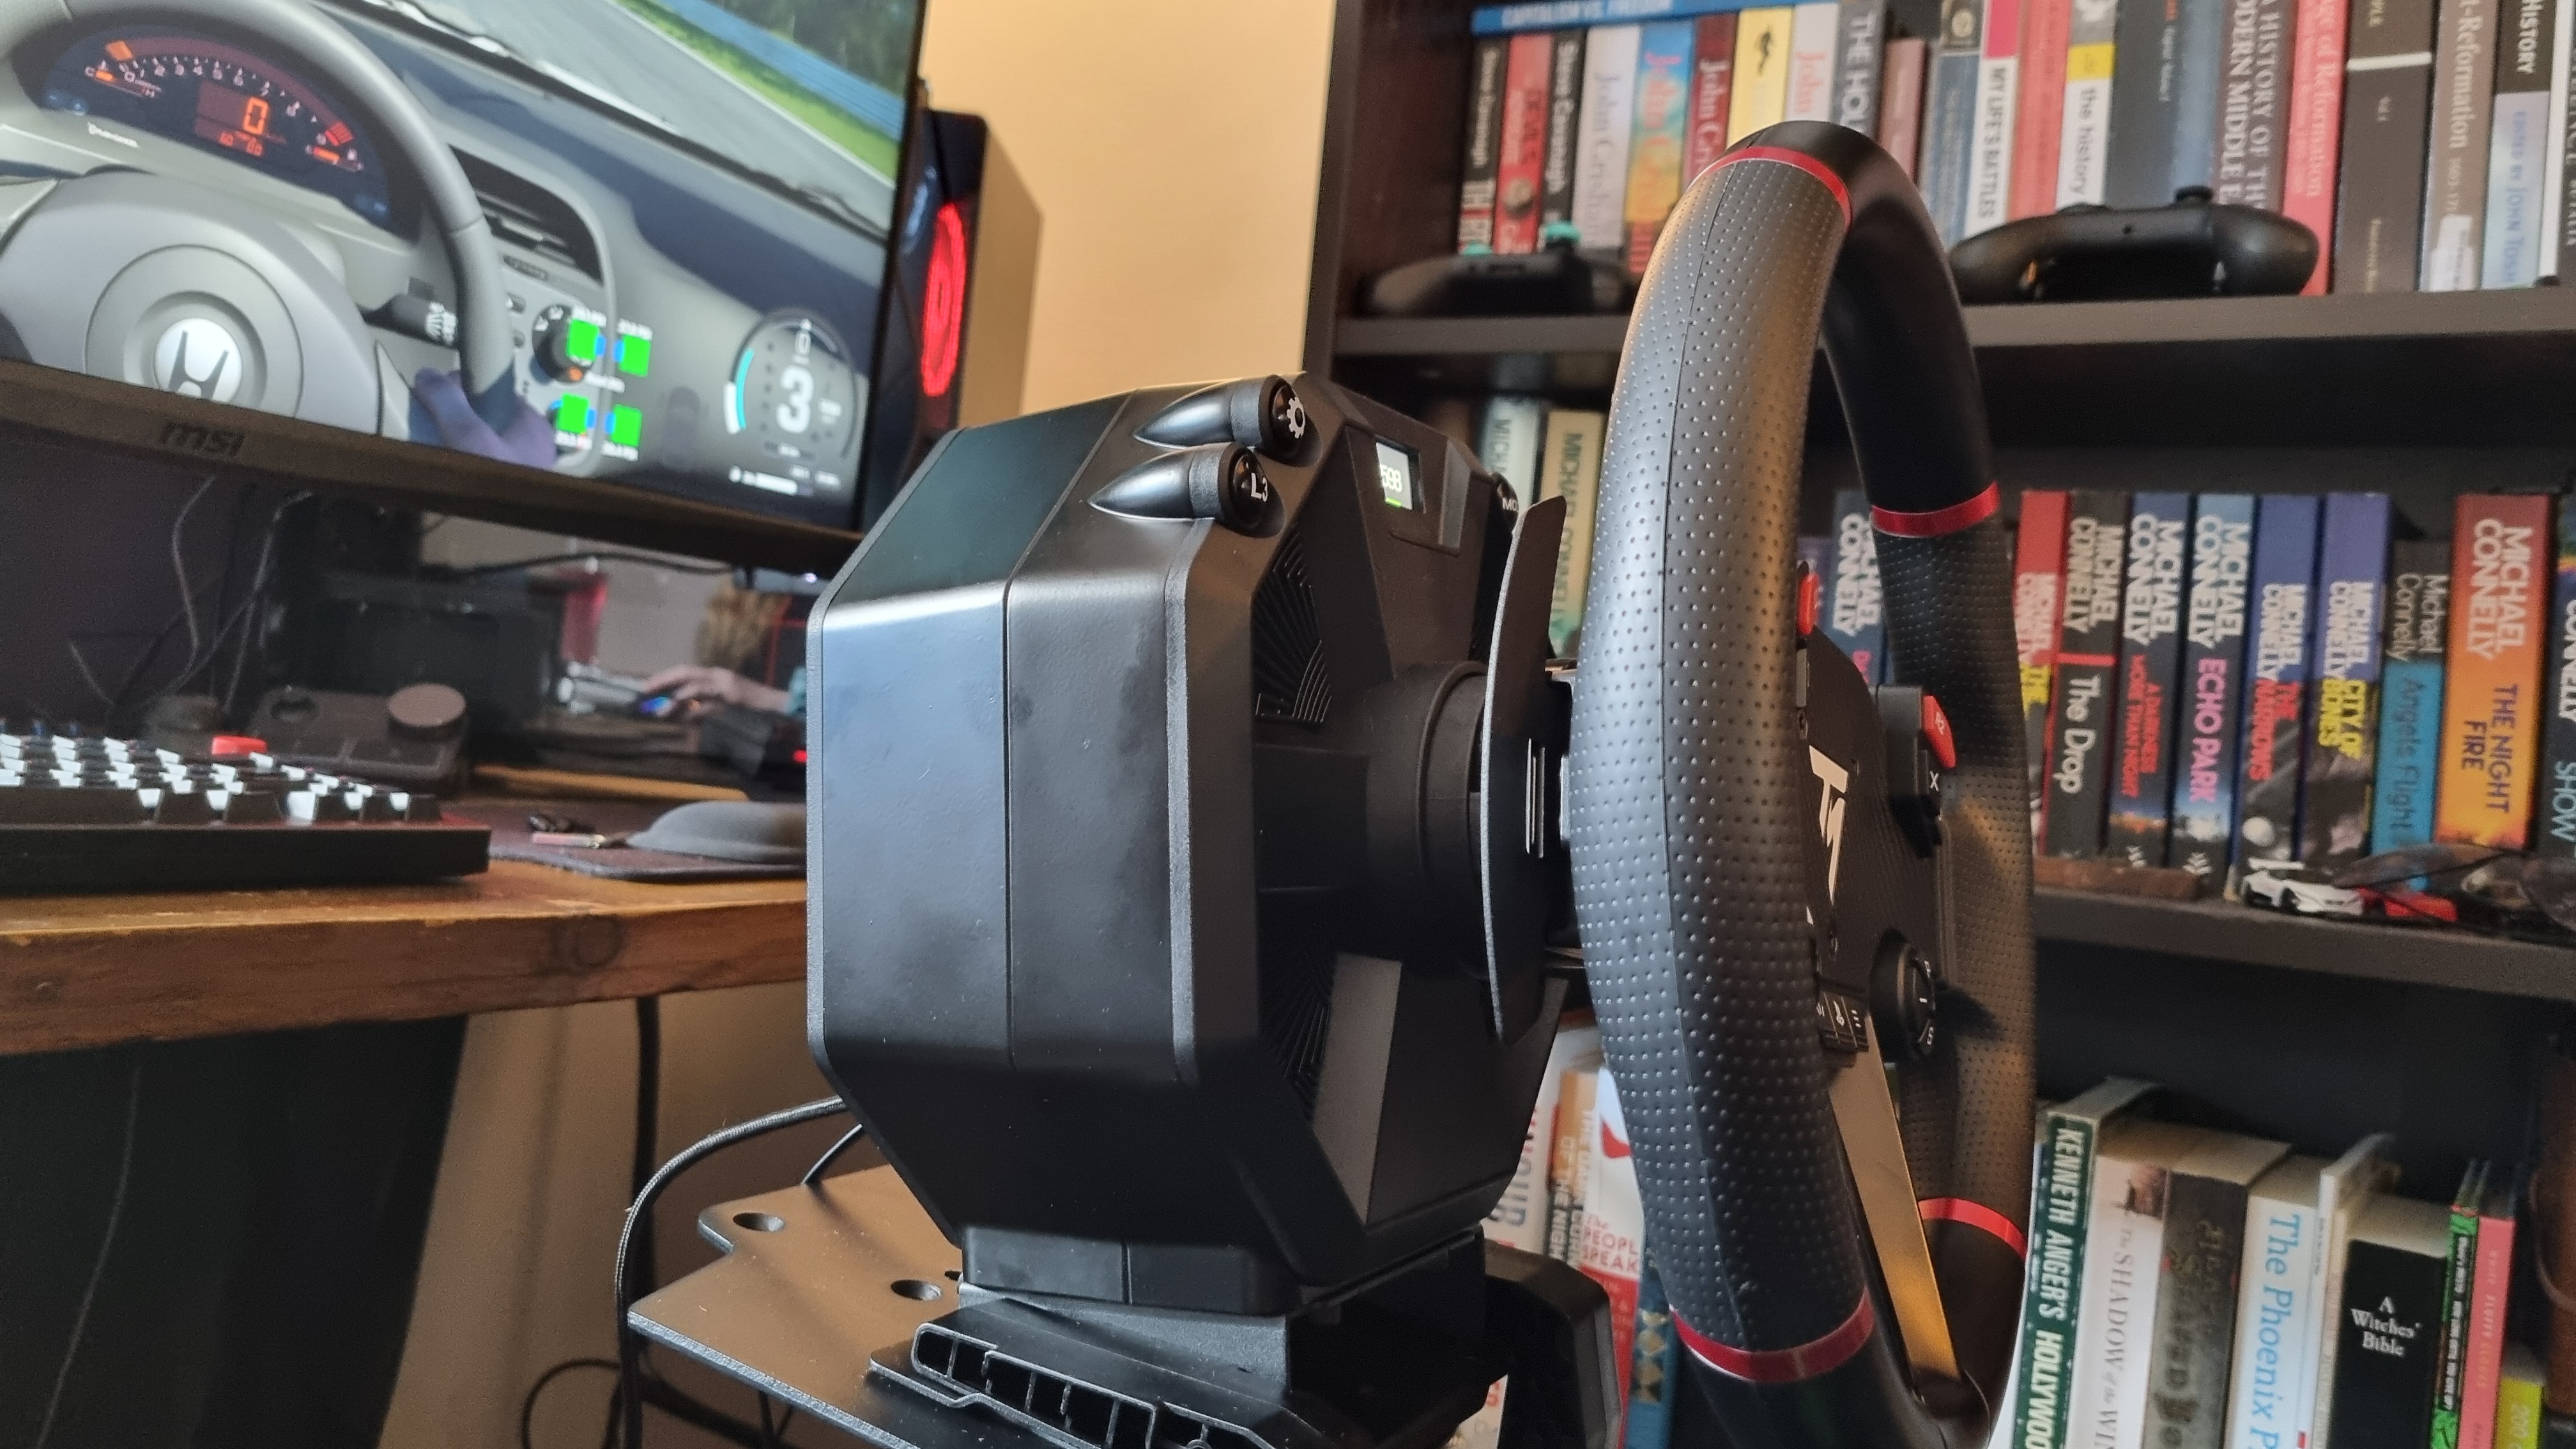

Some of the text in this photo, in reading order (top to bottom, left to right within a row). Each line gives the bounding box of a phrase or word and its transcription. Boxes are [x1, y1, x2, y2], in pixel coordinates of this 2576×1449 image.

[1839, 13, 1876, 133] THE HOU
[2229, 0, 2257, 76] ODERN
[2252, 12, 2281, 118] HISTORY
[2449, 0, 2484, 150] t-Reformation
[1696, 58, 1729, 121] John
[2220, 80, 2252, 181] MIDDLE
[2069, 87, 2099, 197] the history
[2248, 125, 2270, 157] OF
[2244, 164, 2268, 210] TH
[160, 421, 247, 456] msi
[776, 364, 815, 434] 3
[1250, 472, 1269, 503] L3
[1379, 464, 1404, 493] 598
[1501, 497, 1519, 512] MO
[2063, 515, 2097, 634] CONNELLY
[2090, 524, 2126, 630] MICHAEL
[2123, 512, 2158, 647] CONNELLY
[2150, 519, 2186, 640] MICHAEL
[2187, 514, 2222, 650] CONNELLY
[2214, 519, 2250, 641] MICHAEL
[2419, 574, 2450, 654] Michael
[2466, 517, 2504, 662] CONNELLY
[2495, 525, 2534, 656] MICHAEL
[2385, 574, 2421, 663] Connelly
[2053, 674, 2101, 795] The Drop
[2188, 657, 2228, 804] ECHO PARK
[2317, 678, 2343, 747] BONES
[2340, 679, 2367, 730] CITY
[2460, 720, 2488, 771] FIRE
[2386, 677, 2426, 830] Angels Flight
[2485, 682, 2519, 814] THE NIGHT
[2550, 760, 2576, 843] SHOW
[1549, 1209, 1567, 1261] NIGH
[1583, 1226, 1639, 1255] PEOPL
[2264, 1213, 2301, 1276] The
[2025, 1127, 2085, 1449] KENNETH ANGER'S HOLLYWOO
[2104, 1251, 2135, 1371] SHADOW
[2350, 1307, 2423, 1339] Witches'
[2378, 1296, 2396, 1315] A
[2251, 1286, 2295, 1419] Phoenix
[2361, 1334, 2406, 1358] Bible
[2094, 1408, 2119, 1449] WI
